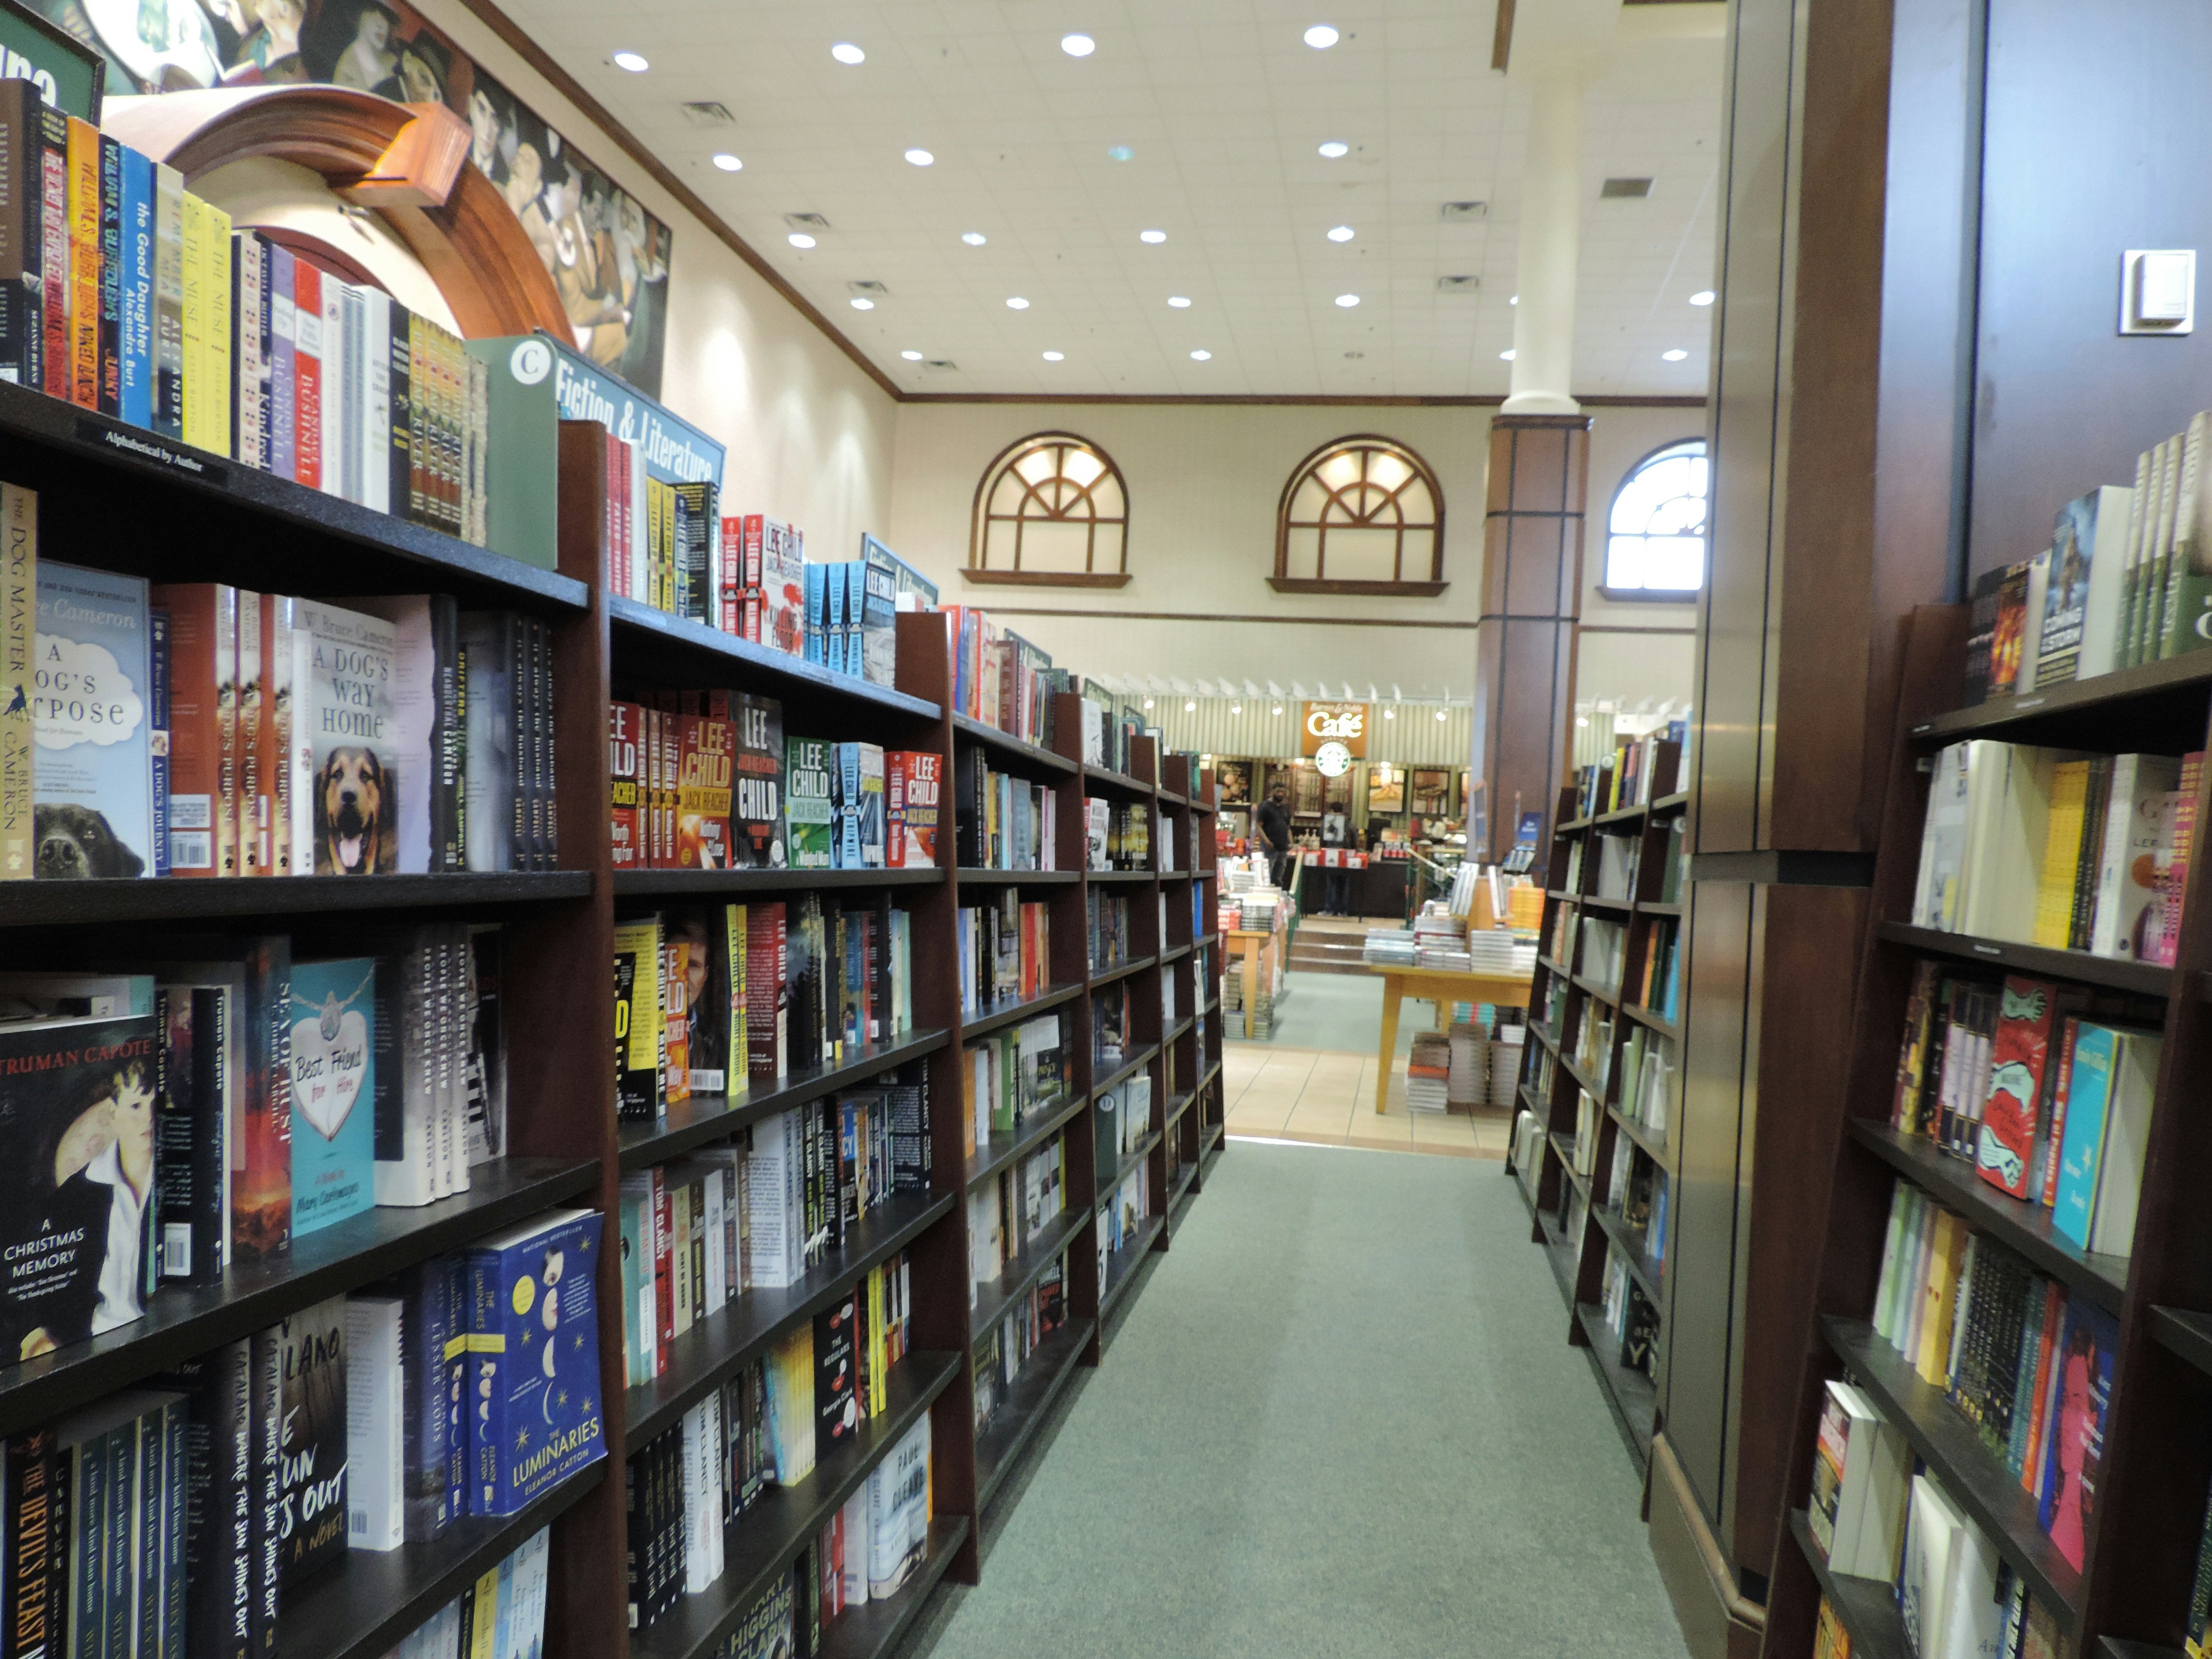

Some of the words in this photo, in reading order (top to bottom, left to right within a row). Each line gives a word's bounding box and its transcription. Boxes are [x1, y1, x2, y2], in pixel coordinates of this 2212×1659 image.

[136, 202, 150, 227] the
[136, 233, 150, 276] Good
[186, 238, 197, 265] THE
[212, 251, 223, 280] THE
[133, 281, 150, 357] Daughter
[186, 280, 198, 324] MUSE
[212, 294, 223, 337] MUSE
[126, 288, 136, 355] Alexandra
[161, 315, 169, 359] BURT
[78, 324, 96, 361] NAKED
[105, 348, 118, 400] JUNKY
[126, 360, 135, 387] Burt
[171, 319, 181, 427] ALEXANDRA
[521, 350, 540, 375] C
[273, 356, 285, 460] BUSHNELL
[556, 359, 615, 424] Fiction
[619, 401, 635, 441] &
[641, 411, 712, 483] Literature
[258, 393, 271, 468] Kindred
[300, 375, 313, 478] BUSHNELL
[413, 417, 423, 469] RIVER
[105, 430, 162, 461] Alphabetical
[161, 447, 173, 465] by
[173, 451, 204, 473] Author
[430, 424, 438, 475] RIVER
[442, 431, 450, 482] RIVER
[677, 523, 686, 540] LEE
[10, 527, 27, 576] DOG
[677, 542, 686, 569] CHILD
[725, 544, 737, 559] LEE
[725, 560, 737, 584] CHILD
[10, 586, 25, 672] MASTER
[54, 598, 136, 629] Cameron
[725, 604, 737, 628] KILLING
[748, 602, 759, 627] KILLING
[47, 643, 61, 661] A
[312, 646, 327, 669] A
[333, 647, 388, 681] DOG'S
[35, 669, 96, 694] OG'S
[1307, 711, 1363, 738] Café
[443, 730, 453, 785] CAMERON
[3, 731, 17, 830] CAMERON
[18, 769, 28, 819] BRUCE
[154, 771, 164, 808] DOG'S
[683, 790, 701, 811] JACK
[703, 791, 729, 812] REACHER
[154, 811, 164, 864] JOURNEY
[846, 820, 855, 858] TRIPWIRE
[439, 944, 447, 990] PEOPLE
[424, 999, 431, 1016] WE
[439, 995, 447, 1012] WE
[459, 994, 466, 1013] WE
[0, 1050, 79, 1077] TRUMAN
[84, 1039, 151, 1064] CAPOTE
[215, 1046, 223, 1090] Capote
[295, 1055, 323, 1082] Best
[331, 1048, 361, 1074] Friend
[657, 1034, 665, 1069] MAKE
[157, 1048, 166, 1092] Capote
[424, 1059, 432, 1095] KNEW
[440, 1054, 448, 1089] KNEW
[656, 1184, 664, 1211] TOM
[41, 1218, 51, 1232] A
[656, 1214, 665, 1261] CLANCY
[4, 1228, 84, 1261] CHRISTMAS
[13, 1249, 76, 1279] MEMORY
[476, 1270, 485, 1330] LUMINARIES
[431, 1322, 441, 1385] LESSER
[432, 1395, 441, 1443] GODS
[148, 1443, 156, 1467] land
[231, 1431, 248, 1481] WHERE
[262, 1416, 278, 1466] WHERE
[512, 1417, 600, 1488] LUMINARIES
[118, 1457, 127, 1481] land
[525, 1469, 558, 1495] ELEANOR
[559, 1447, 589, 1473] CATTON
[117, 1483, 125, 1511] more
[172, 1484, 181, 1509] kind
[303, 1458, 348, 1522] OUT
[54, 1470, 64, 1570] CARVER
[116, 1513, 125, 1538] kind
[147, 1498, 156, 1523] kind
[172, 1511, 181, 1533] than
[264, 1504, 277, 1532] SUN
[18, 1493, 47, 1578] DEVIL'S
[89, 1527, 97, 1554] kind
[147, 1523, 155, 1547] than
[234, 1520, 248, 1550] SUN
[309, 1511, 345, 1551] NOVEL
[116, 1539, 125, 1565] than
[146, 1549, 155, 1579] home
[171, 1535, 180, 1564] home
[264, 1537, 278, 1586] SHINES
[88, 1555, 97, 1581] than
[115, 1567, 124, 1597] home
[234, 1555, 248, 1606] SHINES
[16, 1576, 47, 1649] FEAST
[86, 1584, 95, 1613] home
[264, 1588, 277, 1619] OUT
[234, 1607, 248, 1638] OUT
[730, 1584, 792, 1656] HIGGINS
[738, 1612, 787, 1659] CLARK
